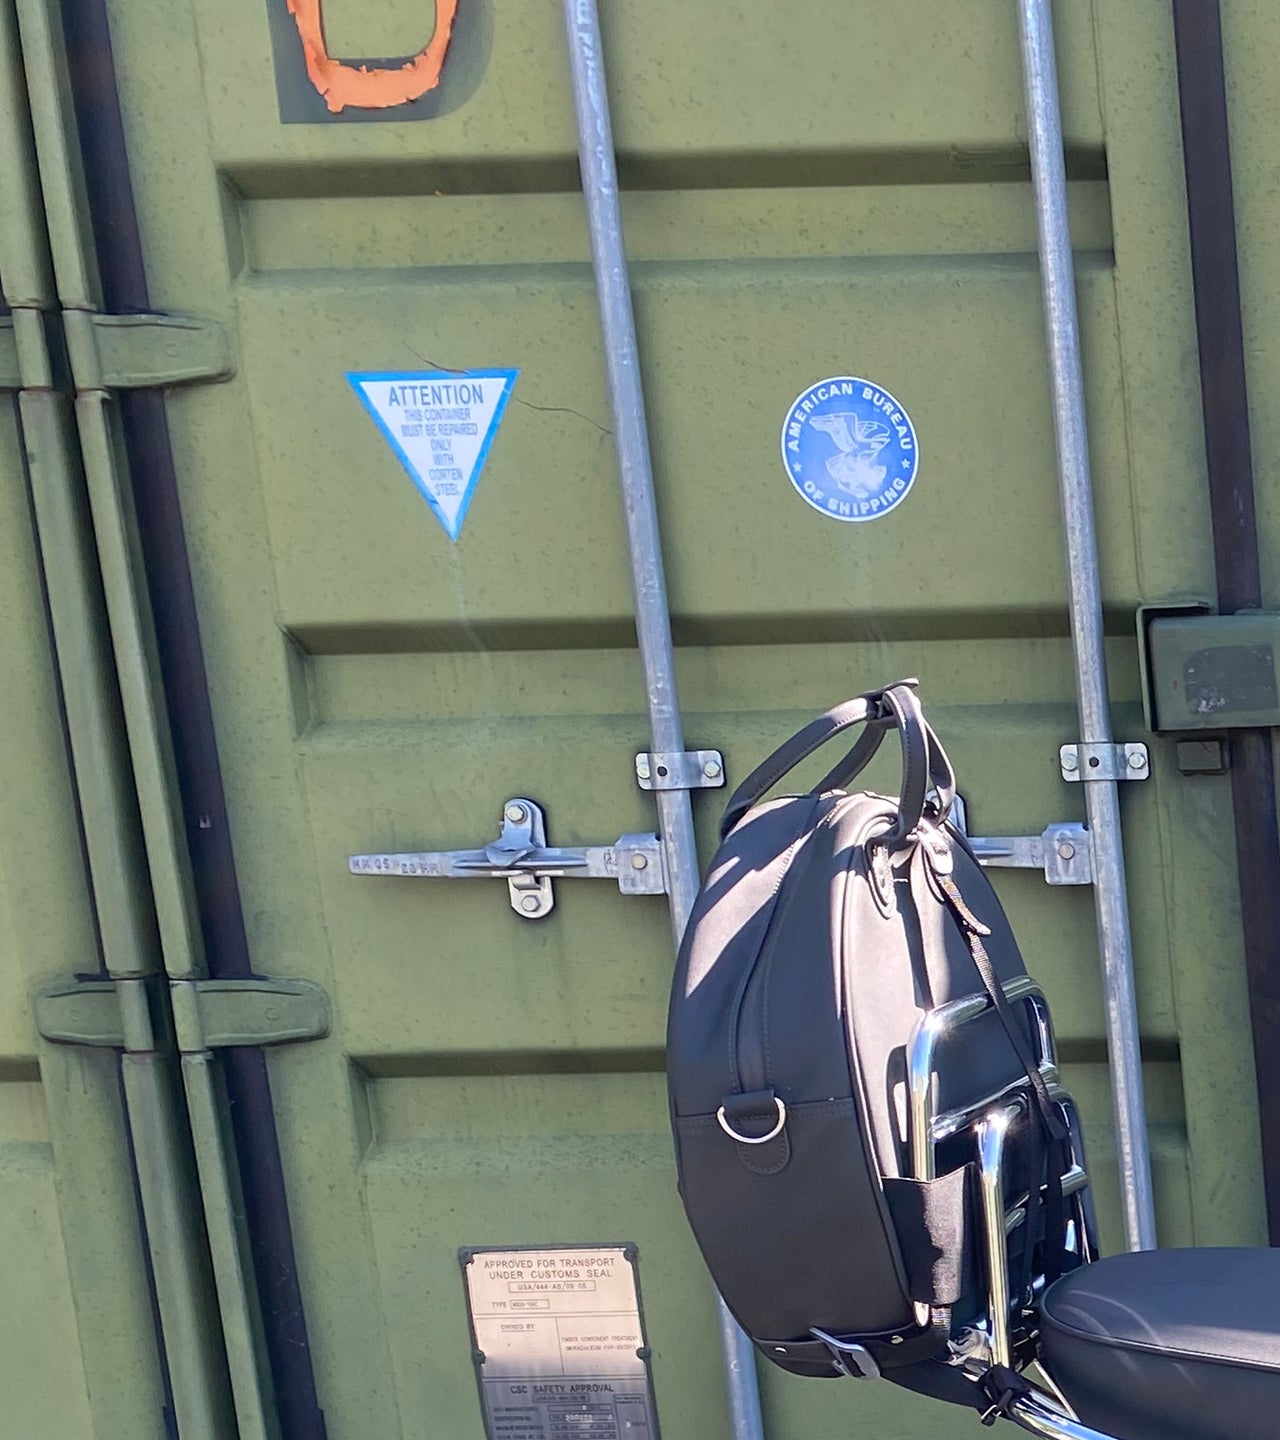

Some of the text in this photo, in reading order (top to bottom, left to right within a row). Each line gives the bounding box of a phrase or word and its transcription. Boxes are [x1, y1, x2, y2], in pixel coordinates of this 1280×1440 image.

[389, 384, 484, 406] ATTENTION
[788, 383, 913, 451] AMERICAN BUREAU
[804, 478, 906, 515] OF SHIPPING
[484, 1257, 615, 1269] APPROVED FOR TRANSPORT
[490, 1269, 613, 1280] UNDER CUSTOMS SEAL
[511, 1384, 614, 1394] CSC SAFETY APPROVAL
